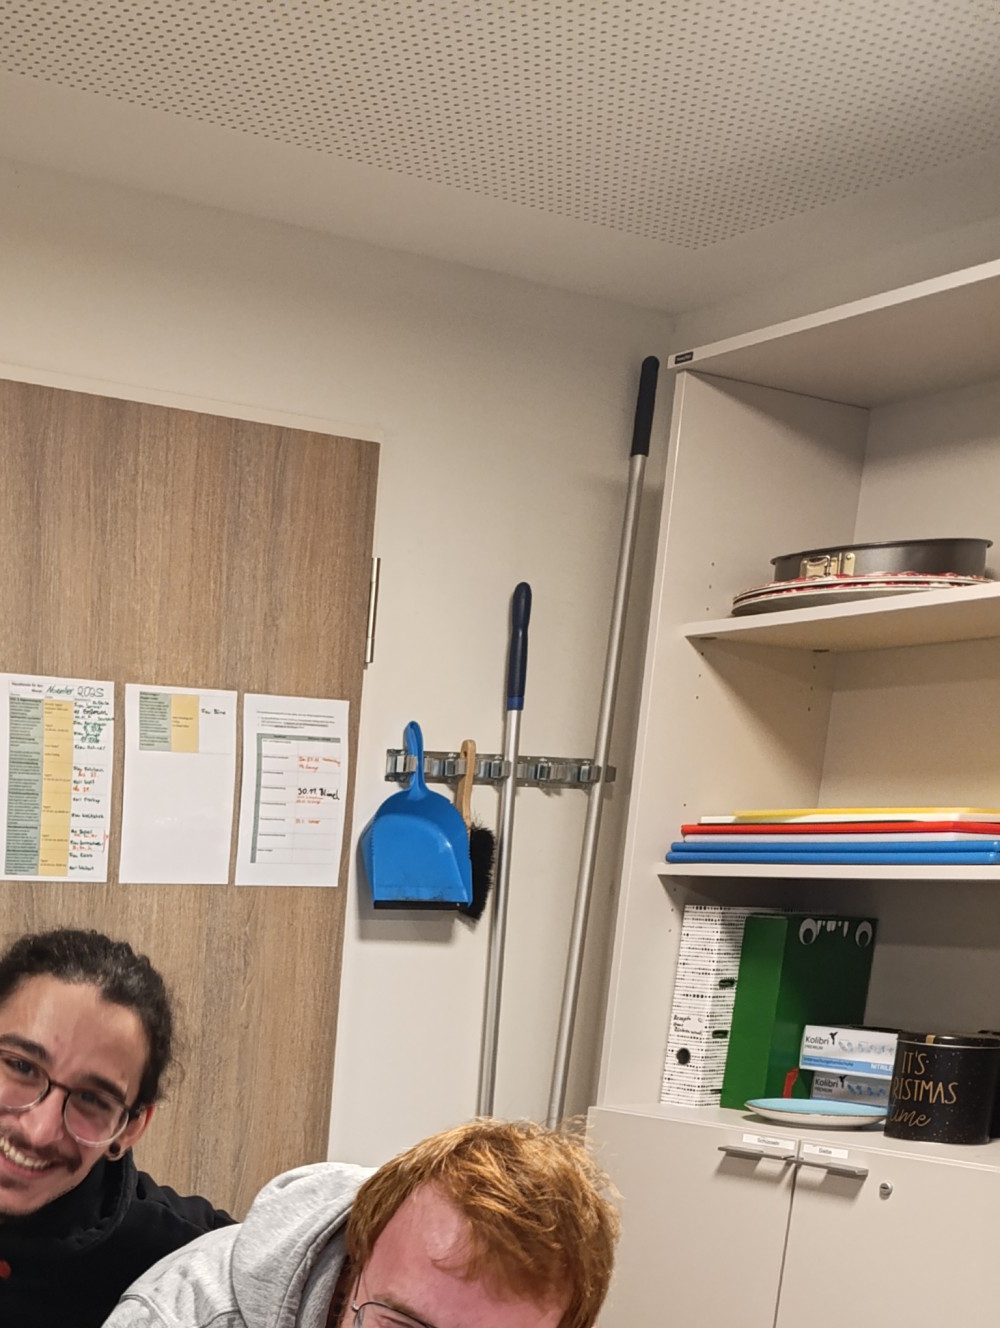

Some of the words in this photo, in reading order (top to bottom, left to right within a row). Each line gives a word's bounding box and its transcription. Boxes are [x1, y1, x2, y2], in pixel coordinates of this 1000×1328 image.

[805, 1035, 830, 1046] Kolibri
[901, 1050, 928, 1075] IT'S
[814, 1078, 839, 1089] Kolibri
